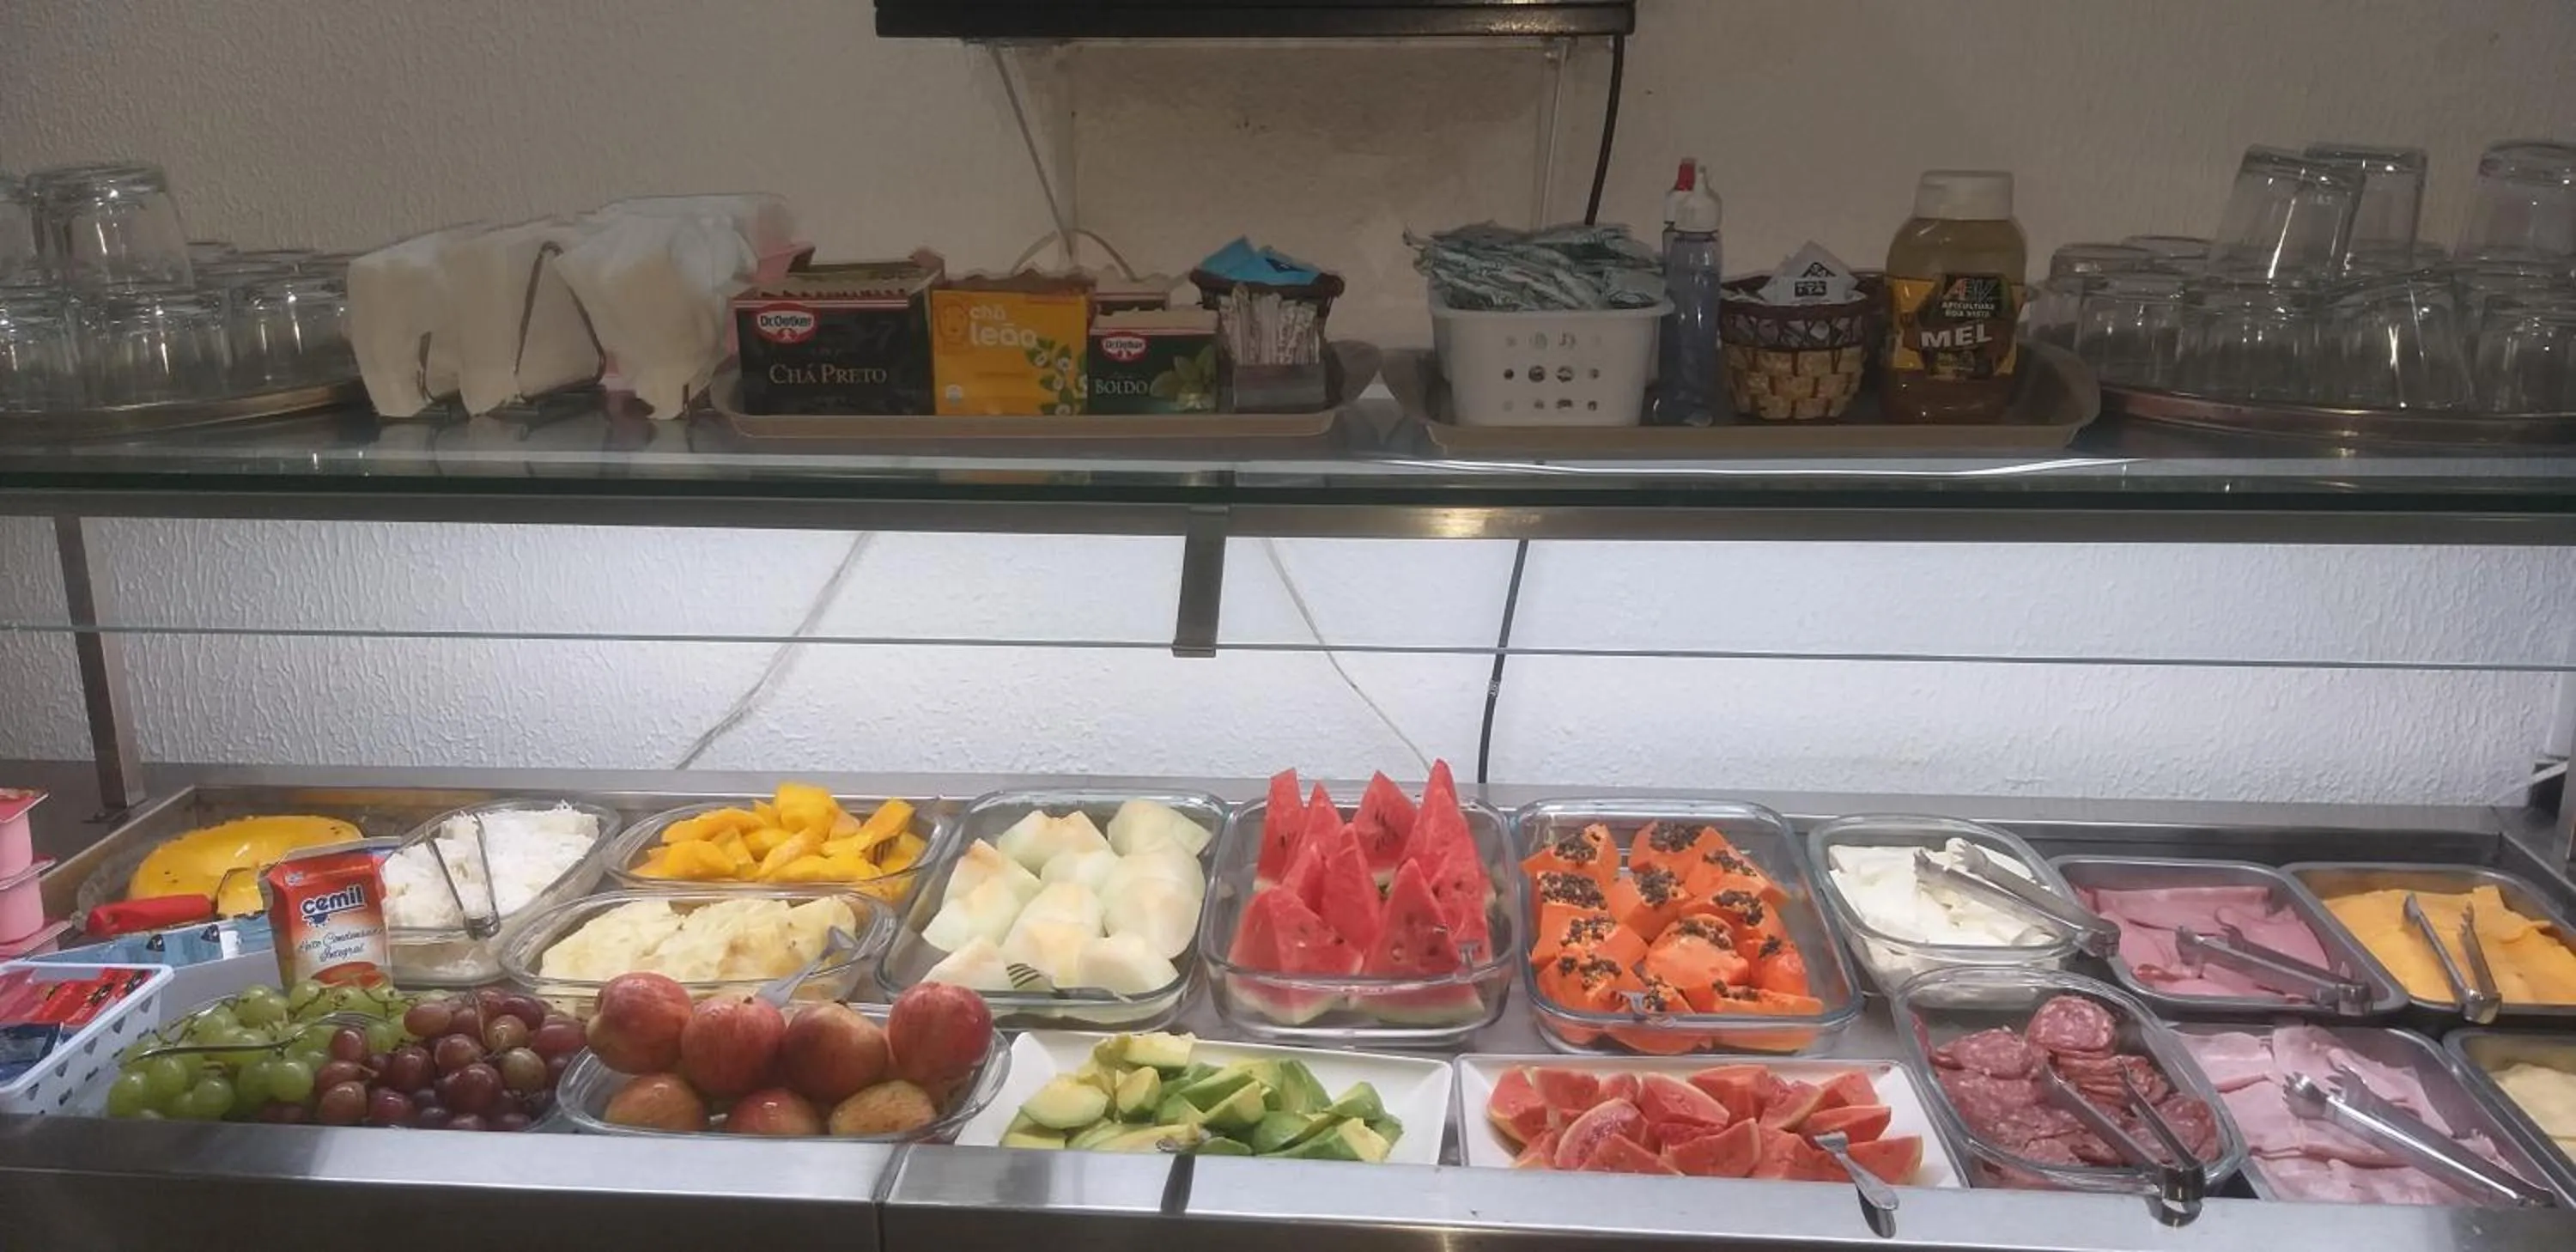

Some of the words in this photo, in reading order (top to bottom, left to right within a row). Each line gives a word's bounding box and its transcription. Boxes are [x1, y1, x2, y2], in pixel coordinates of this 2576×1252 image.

[969, 323, 1037, 349] leão
[1921, 323, 1993, 349] MEL
[769, 362, 817, 385] CHÁ
[821, 364, 888, 385] PRETO
[1095, 377, 1148, 395] BOLDO
[301, 884, 365, 915] cemil
